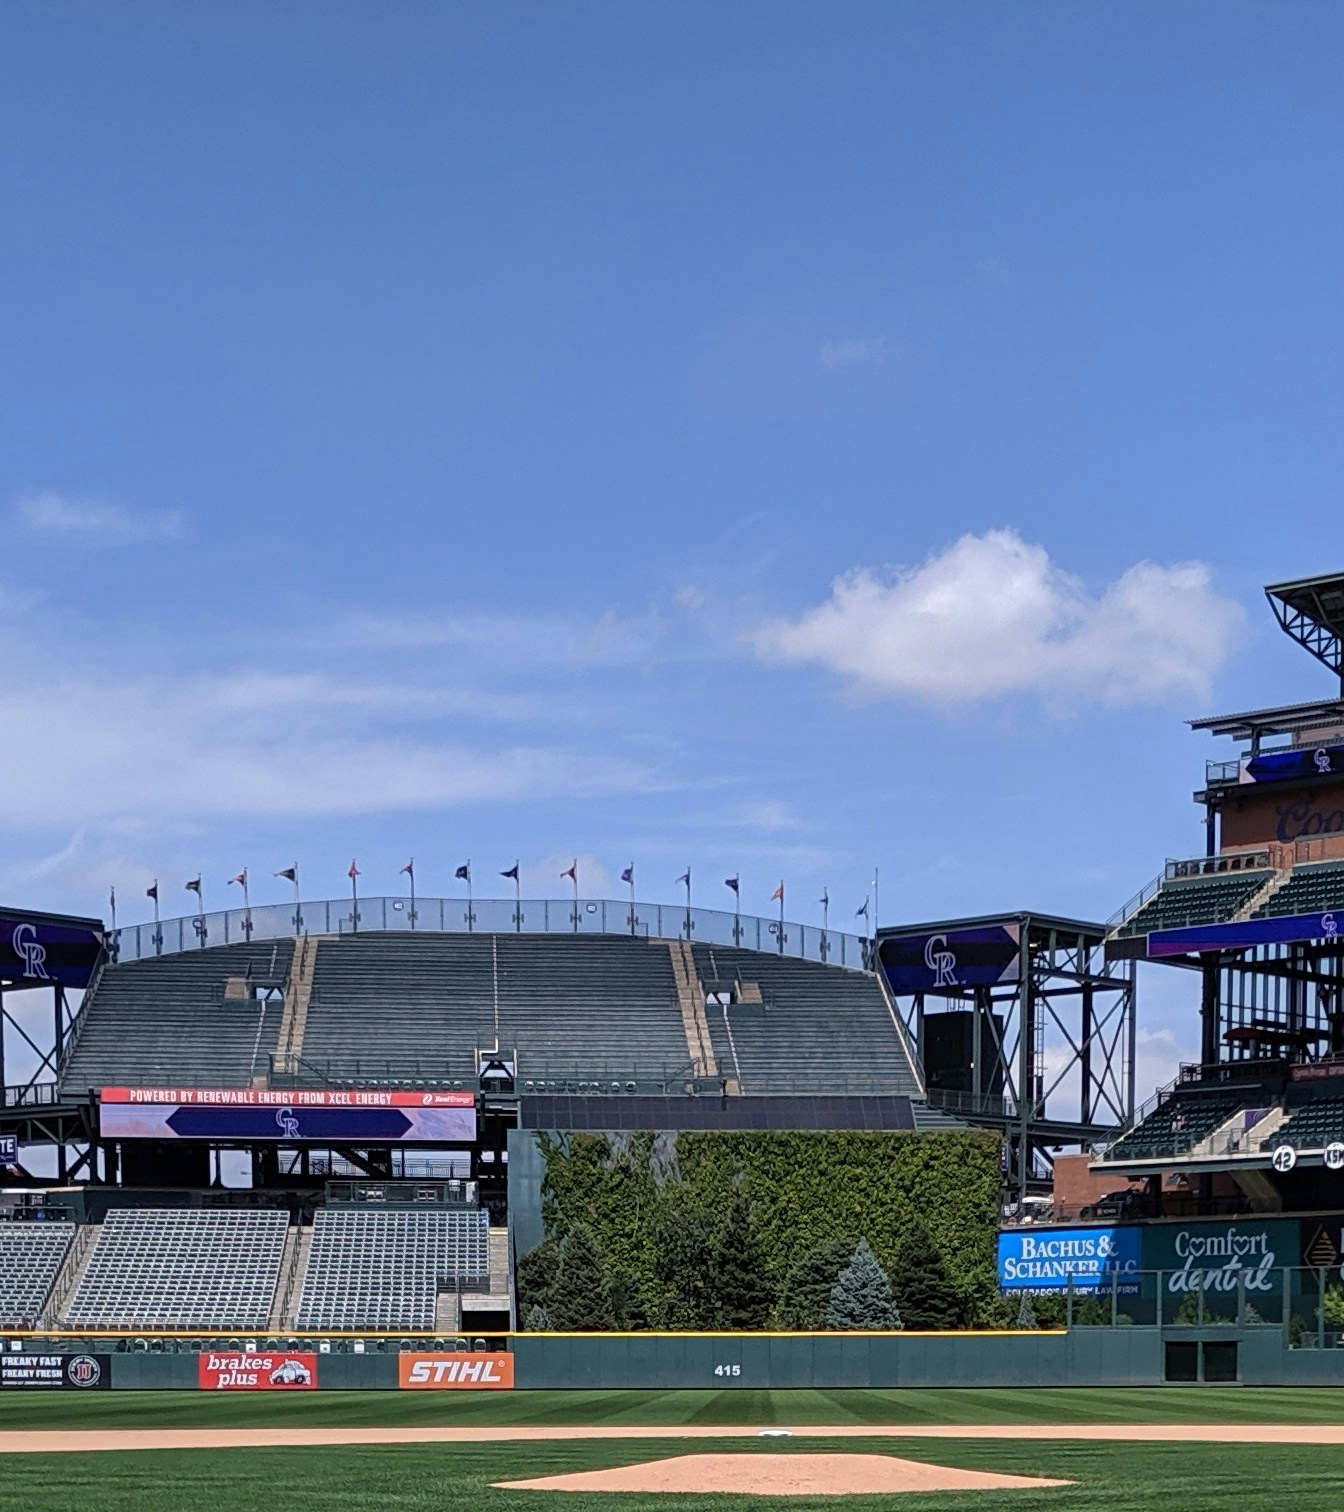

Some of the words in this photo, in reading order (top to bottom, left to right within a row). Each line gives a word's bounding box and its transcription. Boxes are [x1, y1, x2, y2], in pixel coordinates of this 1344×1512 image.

[130, 1090, 177, 1103] POWERED
[180, 1090, 193, 1103] BY
[197, 1091, 255, 1103] RENEWABLE
[258, 1091, 294, 1104] ENERGY
[298, 1092, 326, 1104] FROM
[328, 1092, 353, 1105] XCEL
[356, 1092, 392, 1105] ENERGY
[1274, 1152, 1291, 1169] 42
[1021, 1236, 1095, 1260] BACHUS
[1097, 1235, 1119, 1257] &
[1175, 1228, 1268, 1258] Comfort
[1004, 1258, 1102, 1280] SCHANKER
[1, 1357, 38, 1366] FREAKY
[39, 1357, 63, 1366] FAST
[207, 1355, 273, 1371] brakes
[2, 1369, 35, 1378] FREAKY
[36, 1369, 63, 1378] FRESH
[408, 1361, 502, 1382] STIHL
[714, 1365, 741, 1377] 415
[217, 1371, 257, 1389] plus
